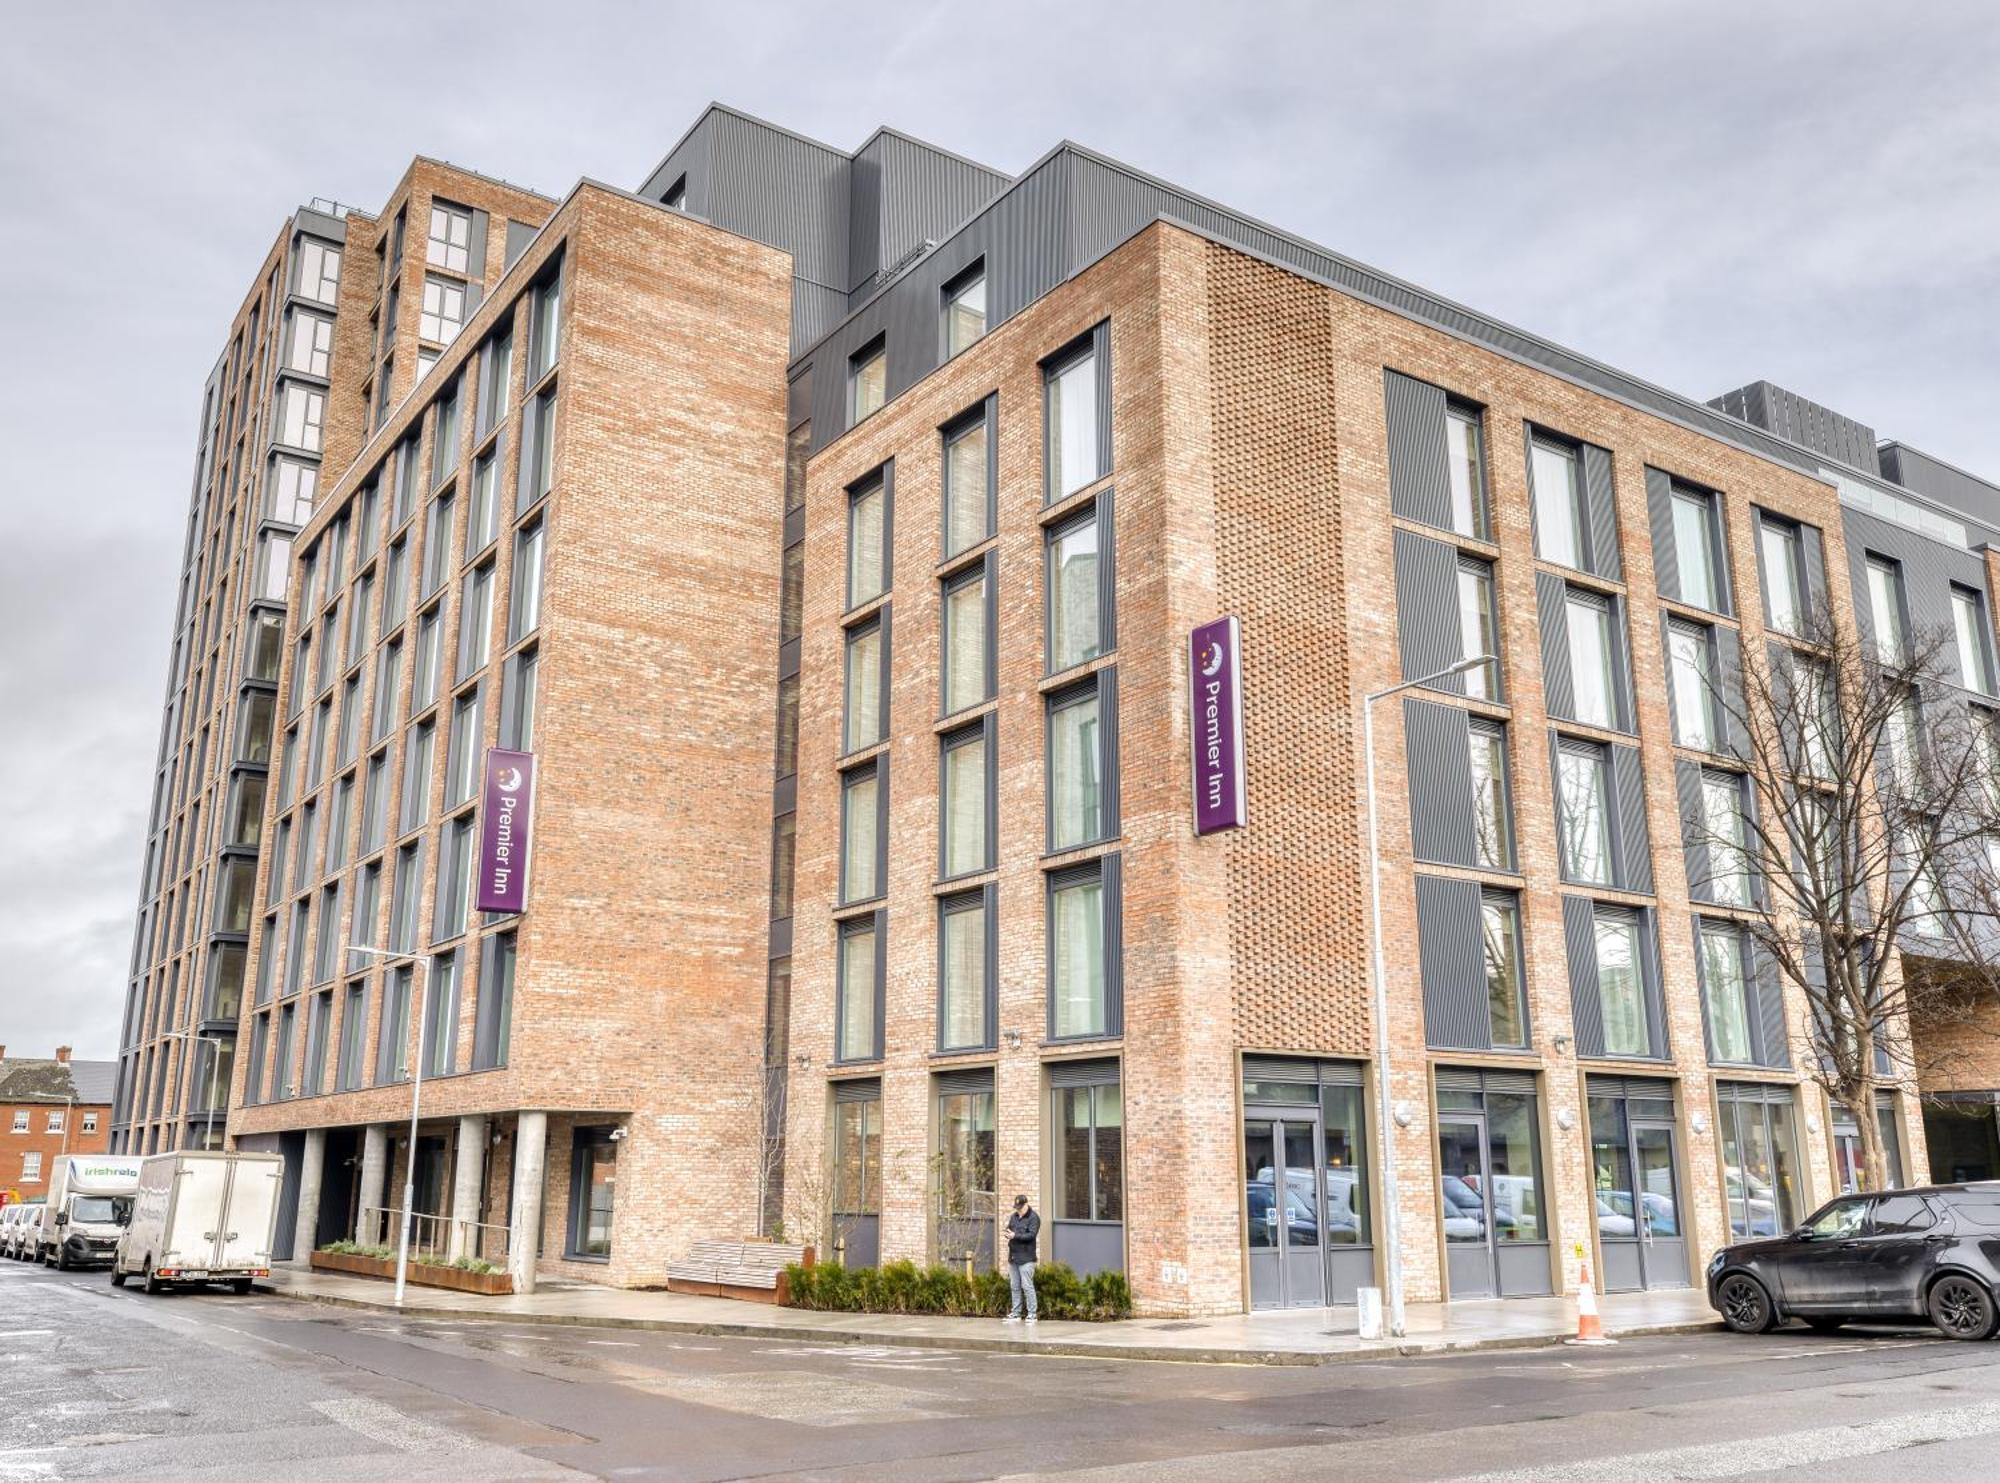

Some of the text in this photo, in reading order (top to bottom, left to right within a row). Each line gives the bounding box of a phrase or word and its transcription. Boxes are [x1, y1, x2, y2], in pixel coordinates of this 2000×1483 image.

[1206, 681, 1223, 808] Premier Inn
[494, 797, 516, 894] Premier Inn
